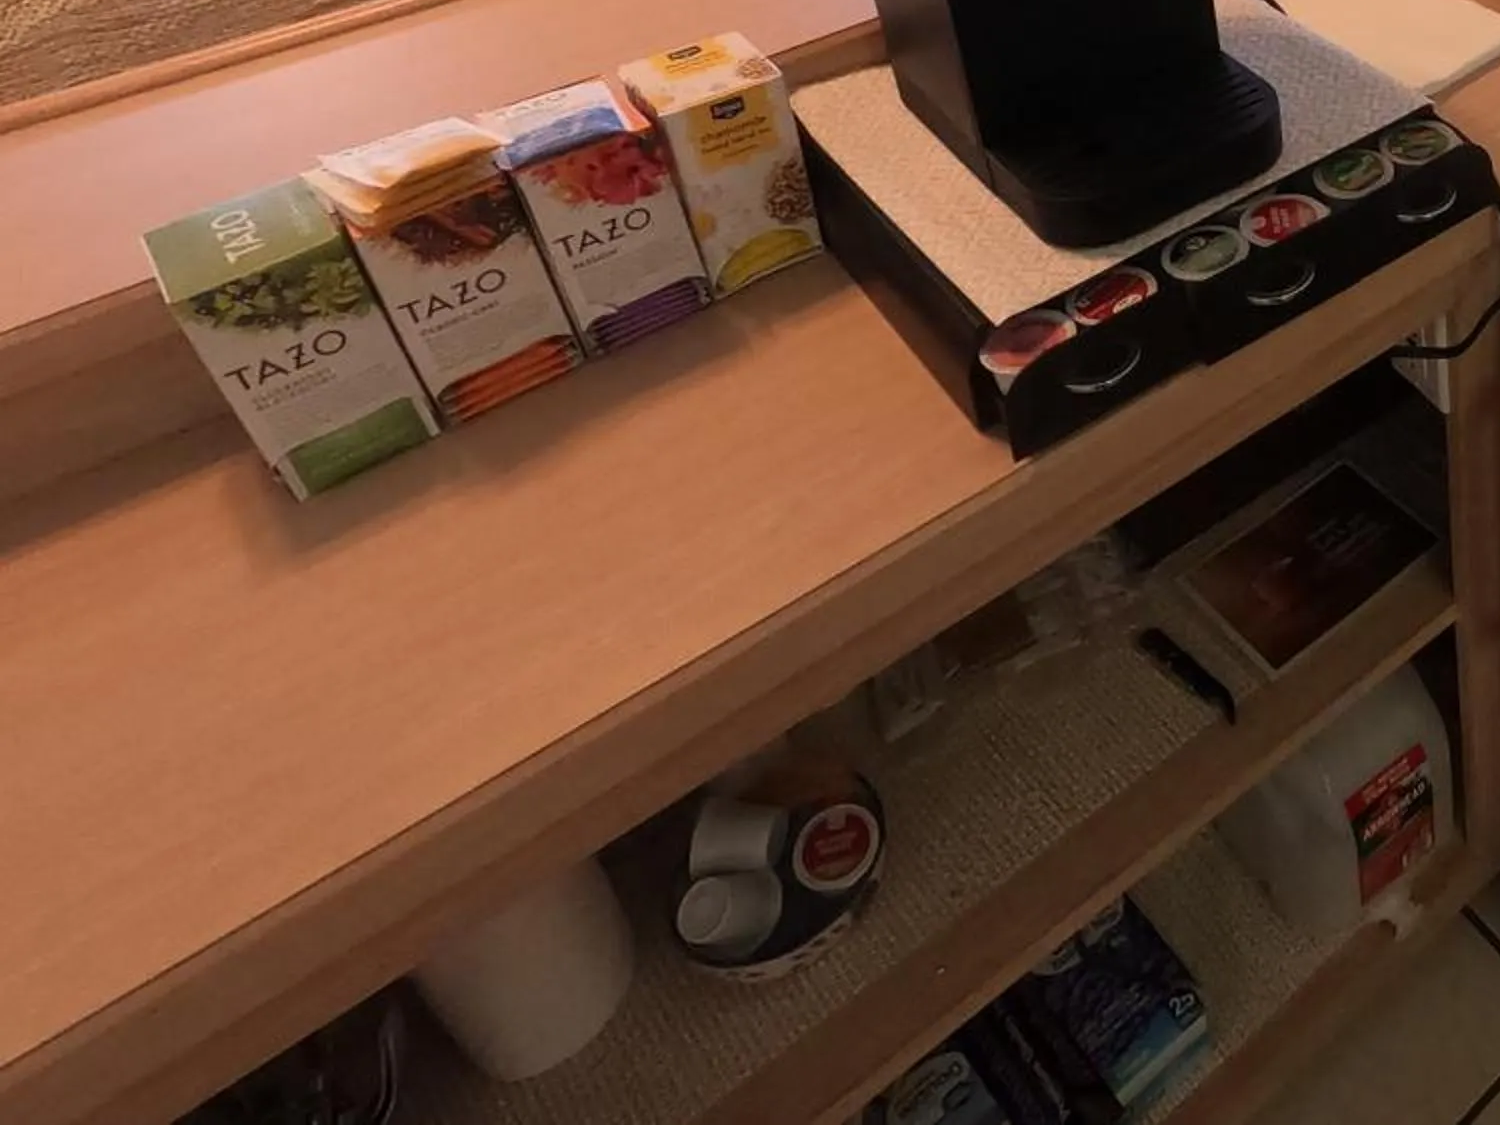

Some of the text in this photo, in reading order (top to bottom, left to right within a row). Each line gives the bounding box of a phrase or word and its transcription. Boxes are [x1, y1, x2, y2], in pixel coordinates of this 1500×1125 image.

[209, 210, 266, 264] TAZO
[552, 208, 651, 257] TAZO
[397, 268, 506, 324] TAZO
[223, 330, 346, 390] TAZO
